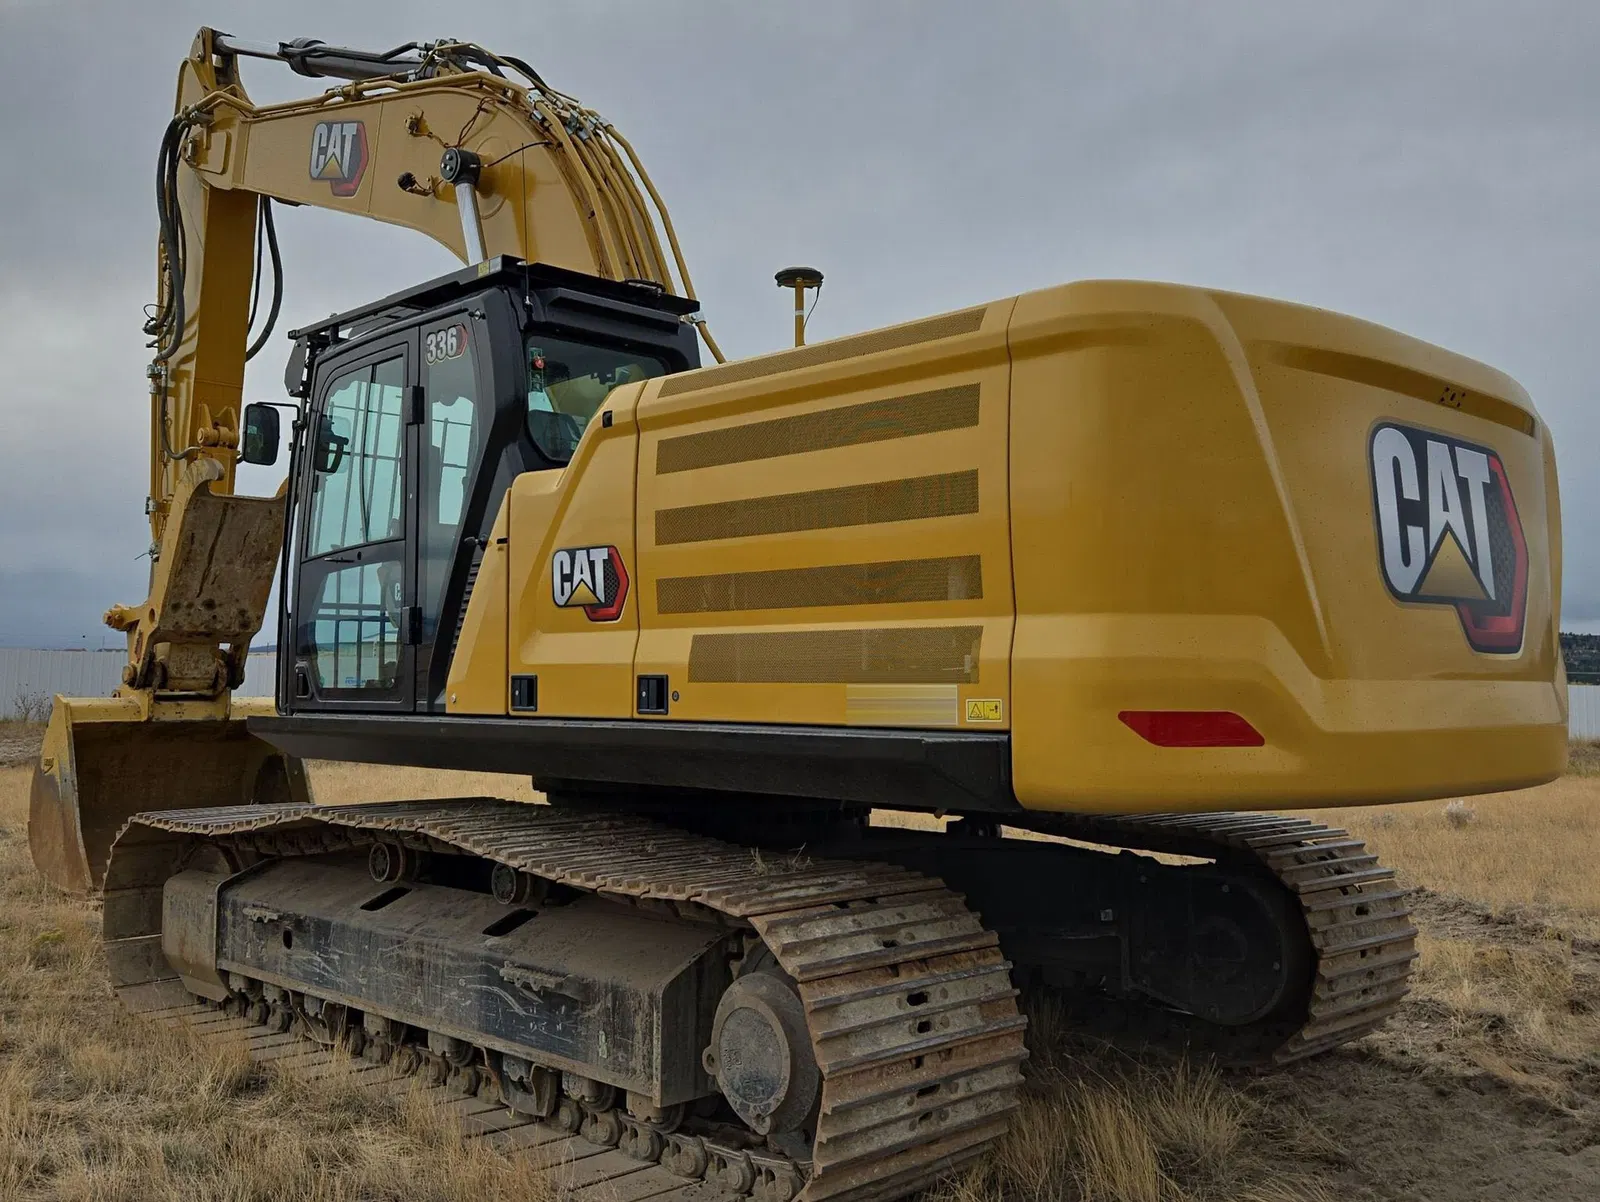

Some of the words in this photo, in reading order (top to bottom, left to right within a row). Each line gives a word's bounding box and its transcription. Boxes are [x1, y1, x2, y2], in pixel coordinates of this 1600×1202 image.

[311, 123, 357, 178] CAT
[427, 327, 457, 362] 336
[1373, 427, 1496, 600] CAT
[553, 547, 608, 606] CAT
